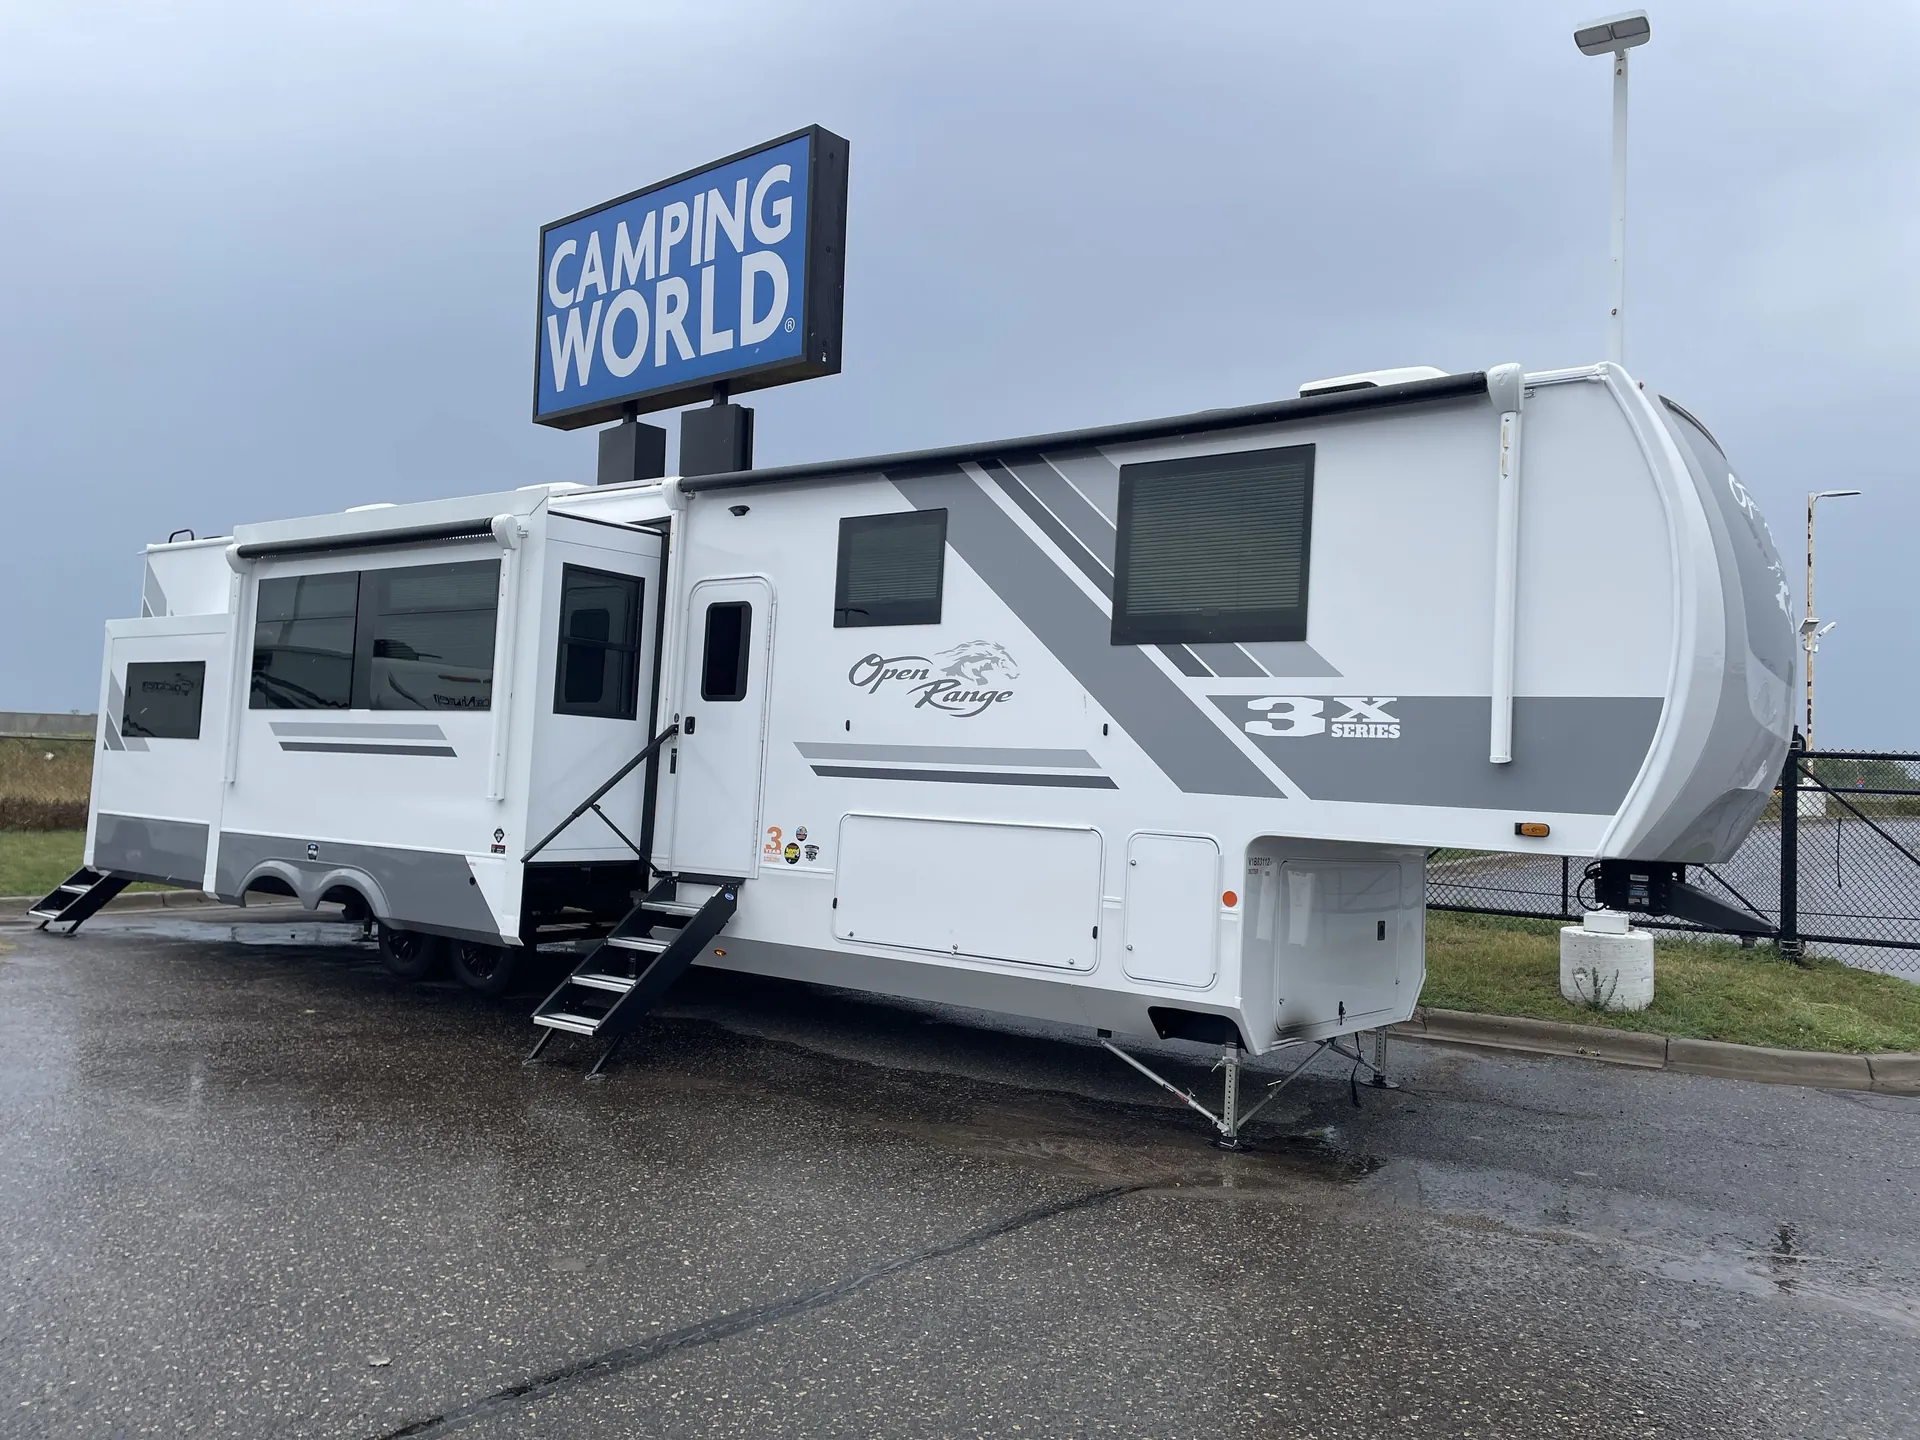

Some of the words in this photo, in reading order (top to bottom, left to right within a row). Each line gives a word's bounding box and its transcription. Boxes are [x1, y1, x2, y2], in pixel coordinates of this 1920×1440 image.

[548, 164, 793, 309] CAMPING
[547, 250, 789, 392] WORLD
[848, 653, 934, 695] Open
[906, 678, 1014, 718] Range
[1331, 723, 1400, 739] SERIES
[765, 826, 783, 849] 3
